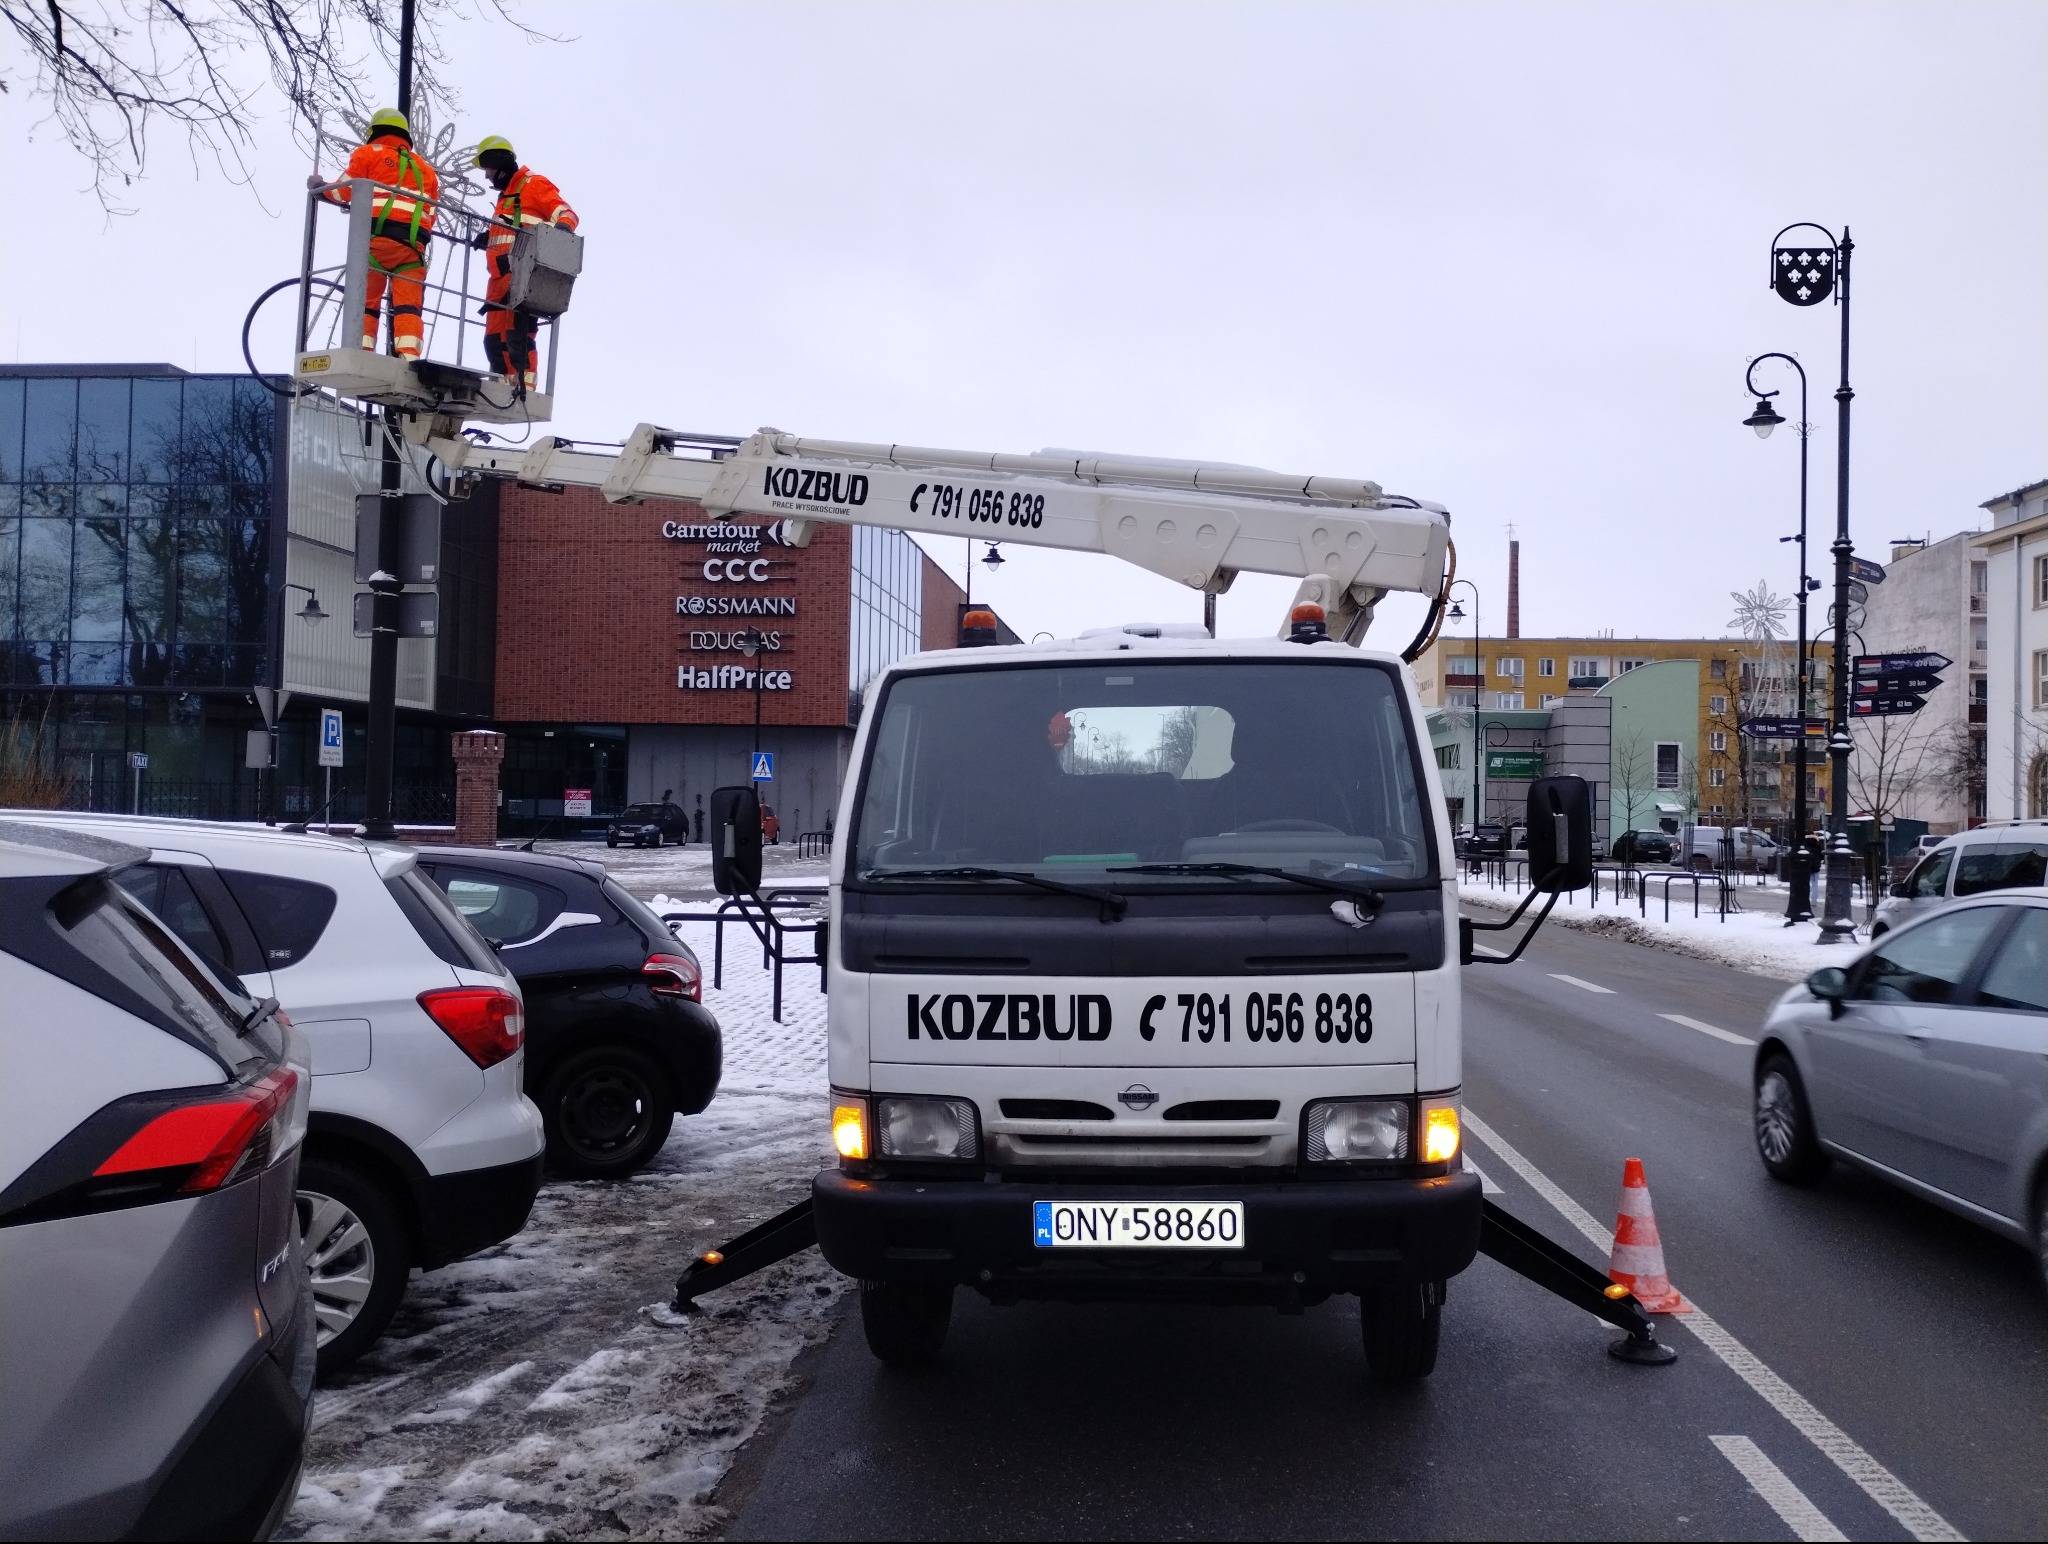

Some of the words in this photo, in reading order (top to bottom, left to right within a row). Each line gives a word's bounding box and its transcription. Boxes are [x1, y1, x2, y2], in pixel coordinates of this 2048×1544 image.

[764, 466, 869, 506] KOZBUD
[772, 500, 794, 510] PRACE
[795, 502, 851, 516] WYSOKOŚCIOWE
[932, 484, 963, 518] 791
[968, 488, 1005, 524] 056
[1008, 492, 1045, 529] 838
[662, 520, 762, 538] Carrefour
[706, 540, 762, 554] market
[703, 558, 769, 582] CCC
[676, 596, 796, 615] ROSSMANN
[691, 631, 781, 650] DOUGAS
[678, 665, 792, 690] HalfPrice
[328, 719, 338, 743] P
[1767, 724, 1777, 732] km
[134, 755, 147, 767] TAXI
[907, 994, 1112, 1041] KOZBUD
[1177, 993, 1231, 1044] 791
[1246, 992, 1305, 1043] 056
[1315, 992, 1373, 1044] 838
[1038, 1228, 1051, 1238] PL
